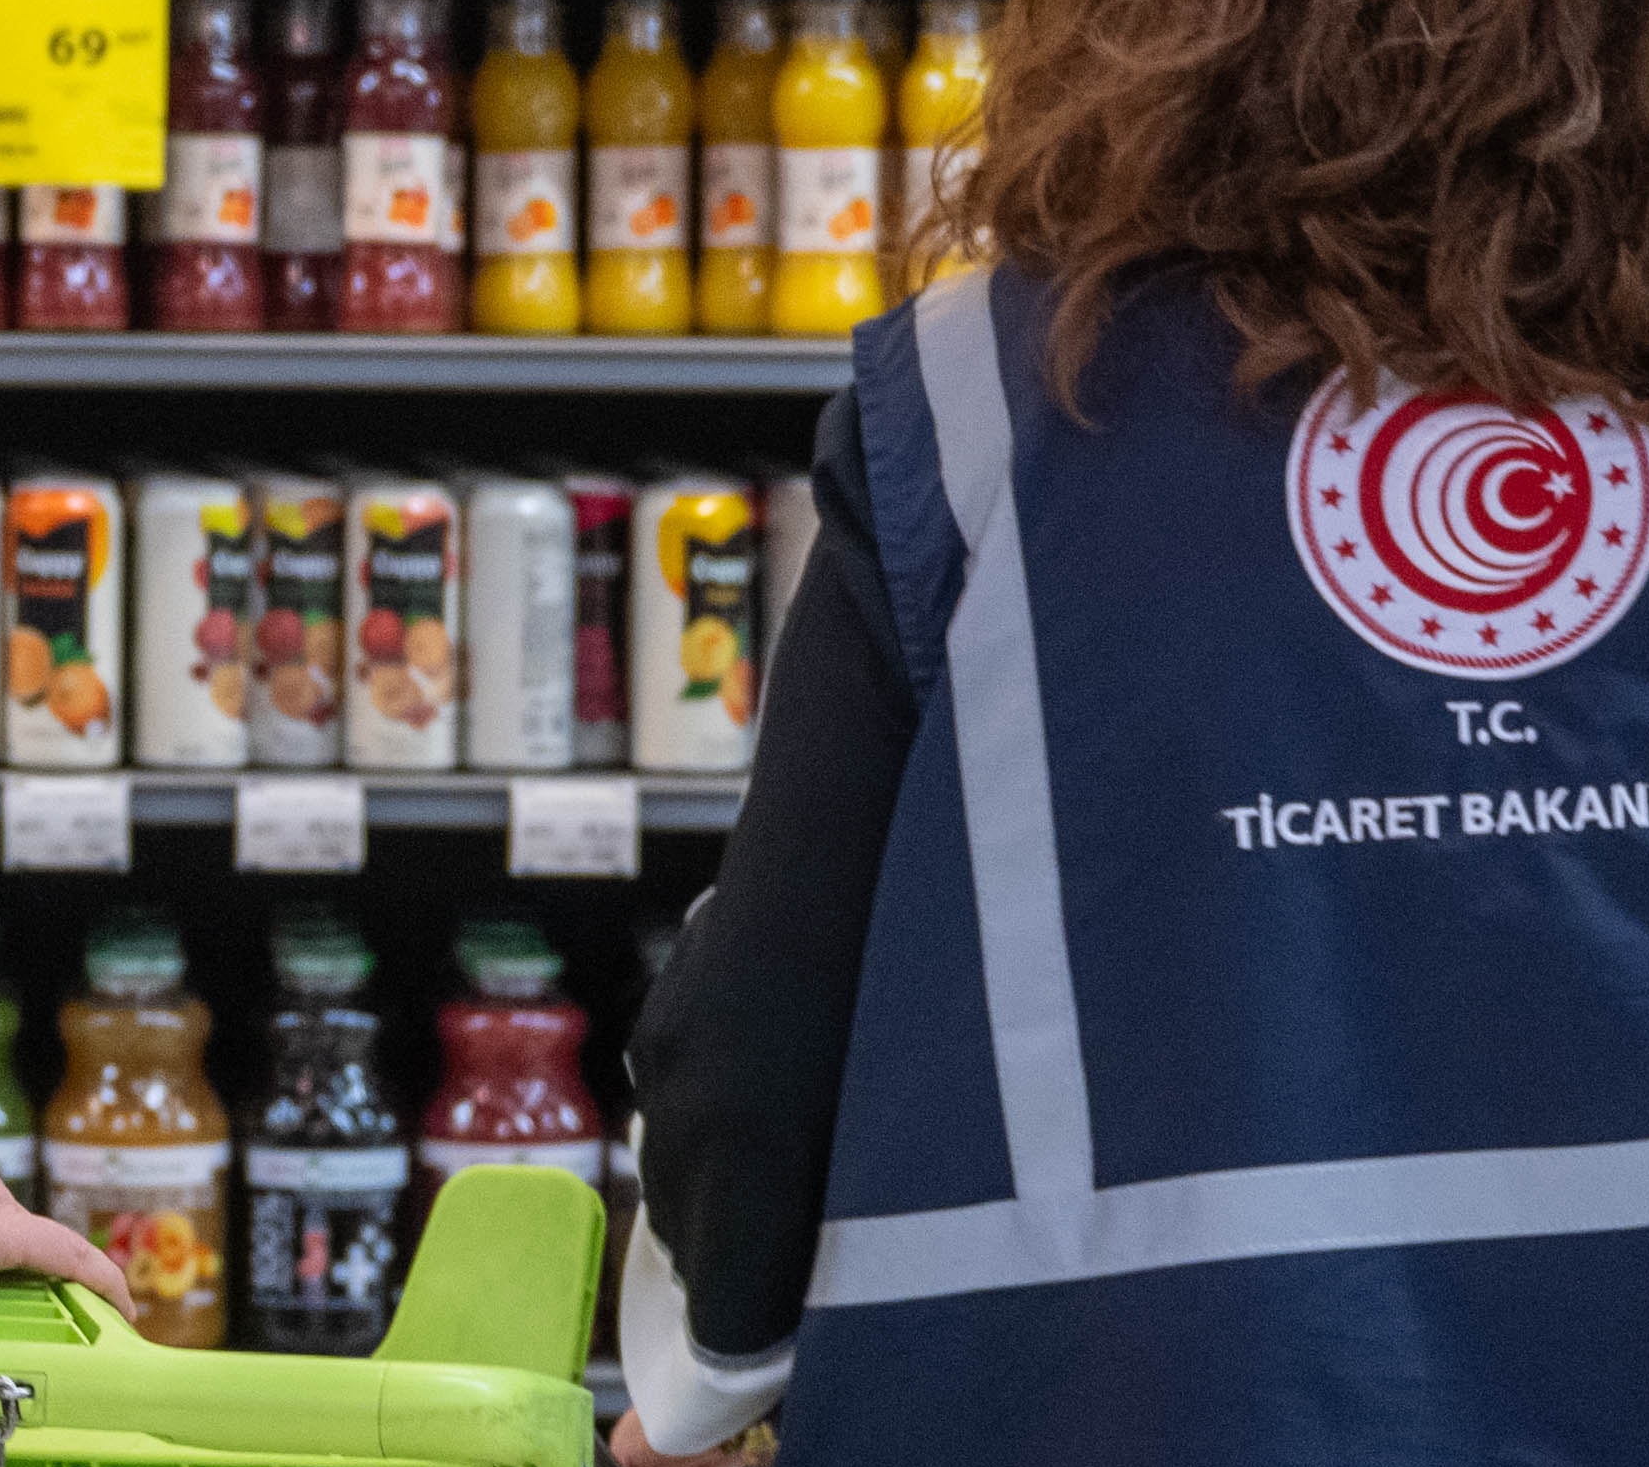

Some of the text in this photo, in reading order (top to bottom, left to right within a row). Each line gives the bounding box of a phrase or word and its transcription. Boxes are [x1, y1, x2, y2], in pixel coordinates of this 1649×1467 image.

[47, 29, 108, 66] 69
[1446, 701, 1538, 747] T.C.
[1221, 791, 1450, 851] TİCARET
